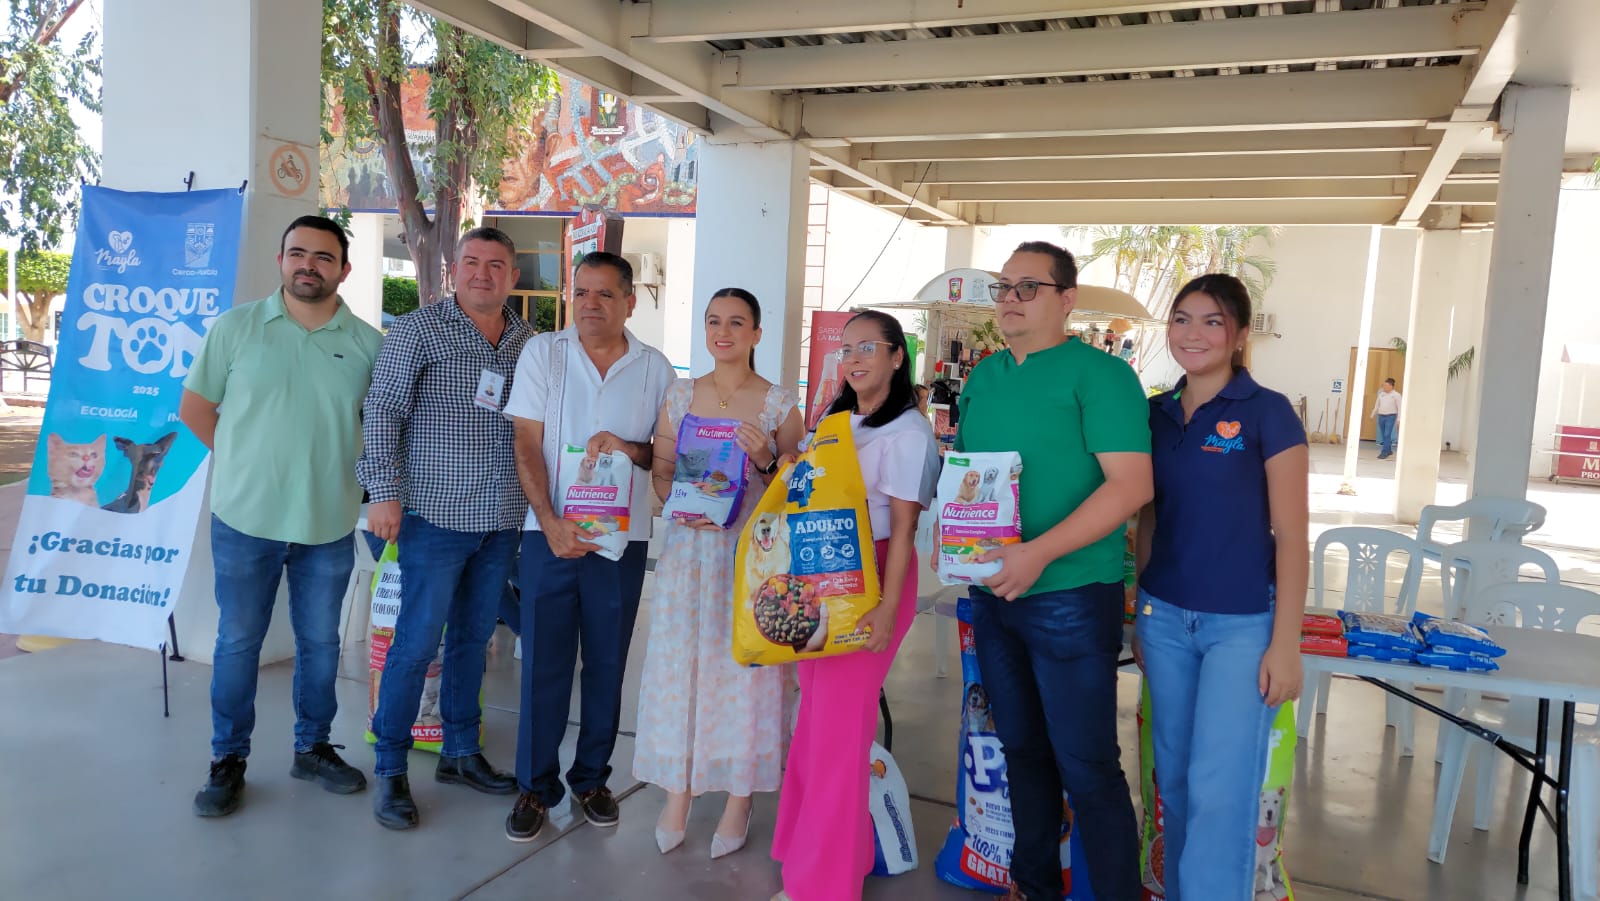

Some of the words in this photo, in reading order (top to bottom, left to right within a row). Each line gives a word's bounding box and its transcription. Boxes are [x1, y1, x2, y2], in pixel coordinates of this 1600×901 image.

[94, 248, 142, 274] Mayla
[83, 283, 220, 321] CROQUE
[133, 385, 160, 397] 2025
[80, 405, 138, 419] ECOLOGÍA
[1204, 435, 1245, 454] Mayla
[567, 488, 615, 500] Nutrience
[944, 507, 996, 519] Nutrience
[795, 518, 854, 534] ADULTO
[28, 531, 143, 559] ¡Gracias
[145, 545, 179, 564] por
[14, 574, 46, 594] tu
[55, 575, 170, 607] Donación!
[972, 834, 1002, 864] 100%
